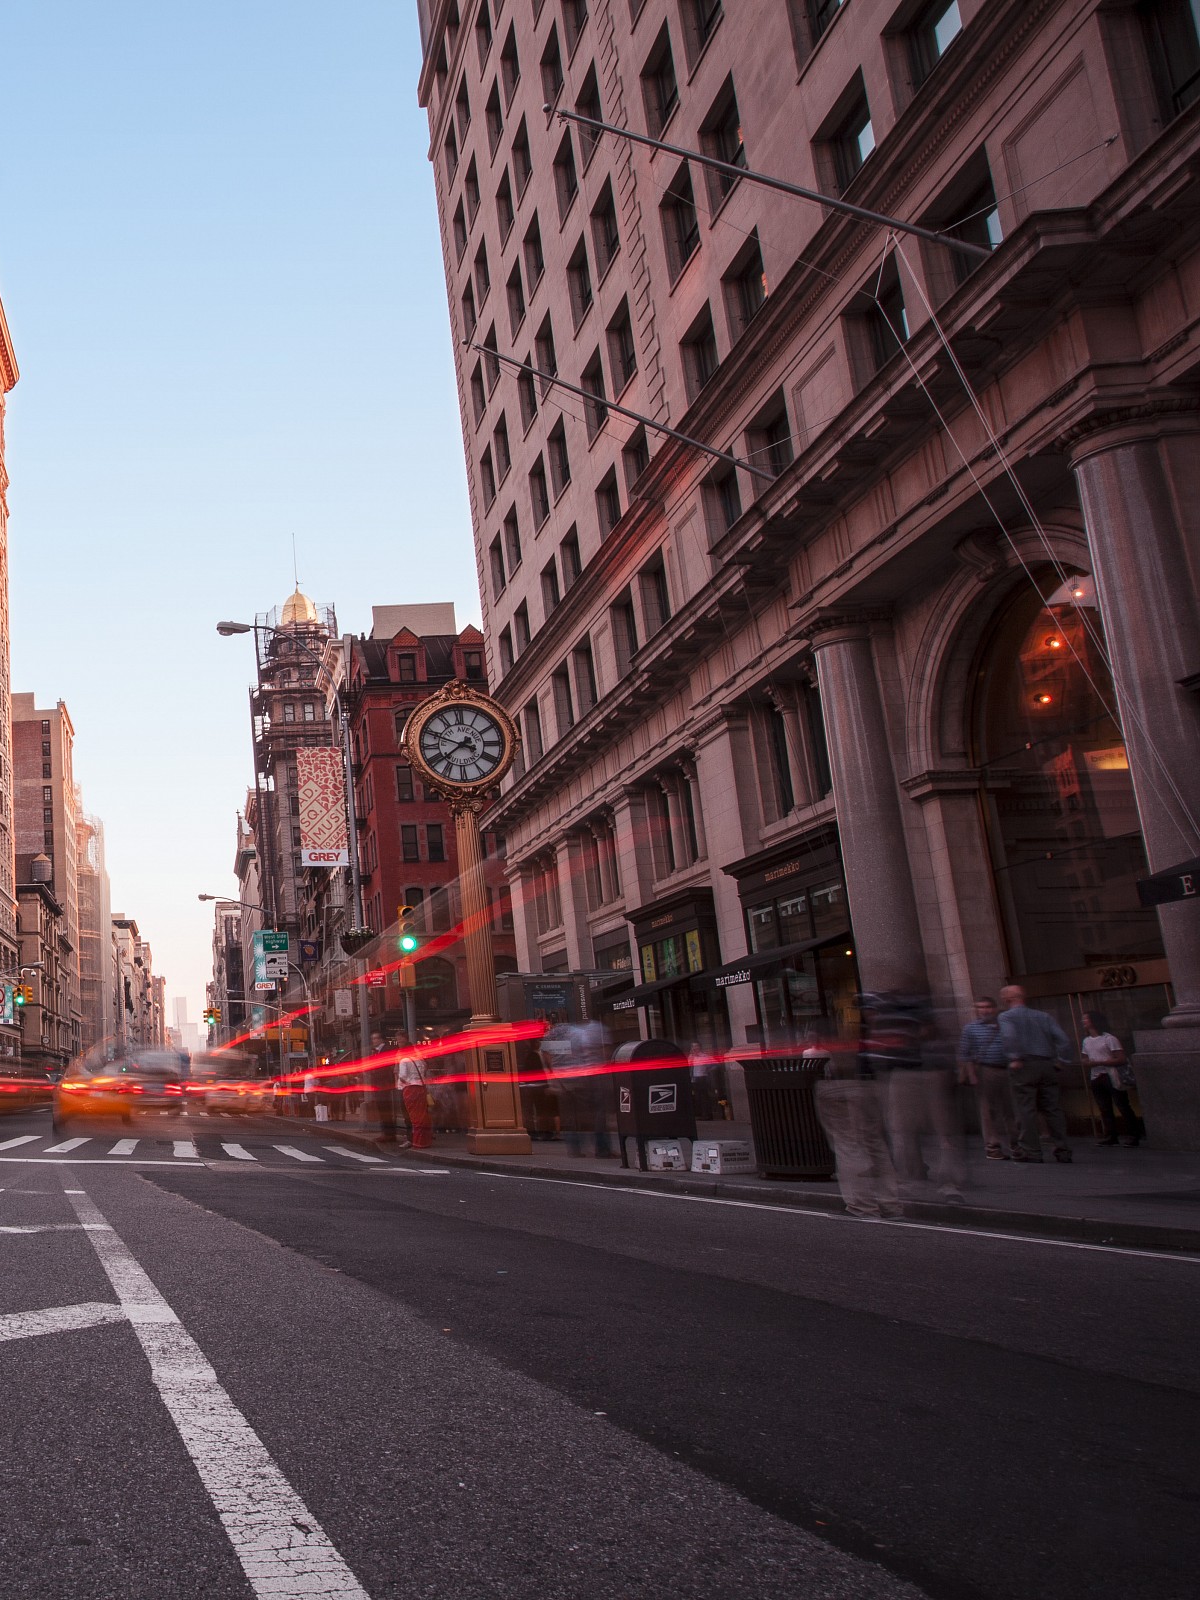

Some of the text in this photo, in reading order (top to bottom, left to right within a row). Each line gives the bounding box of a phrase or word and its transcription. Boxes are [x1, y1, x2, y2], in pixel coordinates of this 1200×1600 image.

[441, 726, 481, 747] FITH AVENUE
[448, 751, 480, 765] UILDING
[301, 809, 323, 828] SQ.
[323, 841, 331, 849] 10
[308, 852, 341, 862] GREY
[764, 861, 800, 882] marimekko
[1179, 875, 1196, 896] E
[714, 969, 751, 987] marimekko
[613, 998, 636, 1011] marimekko
